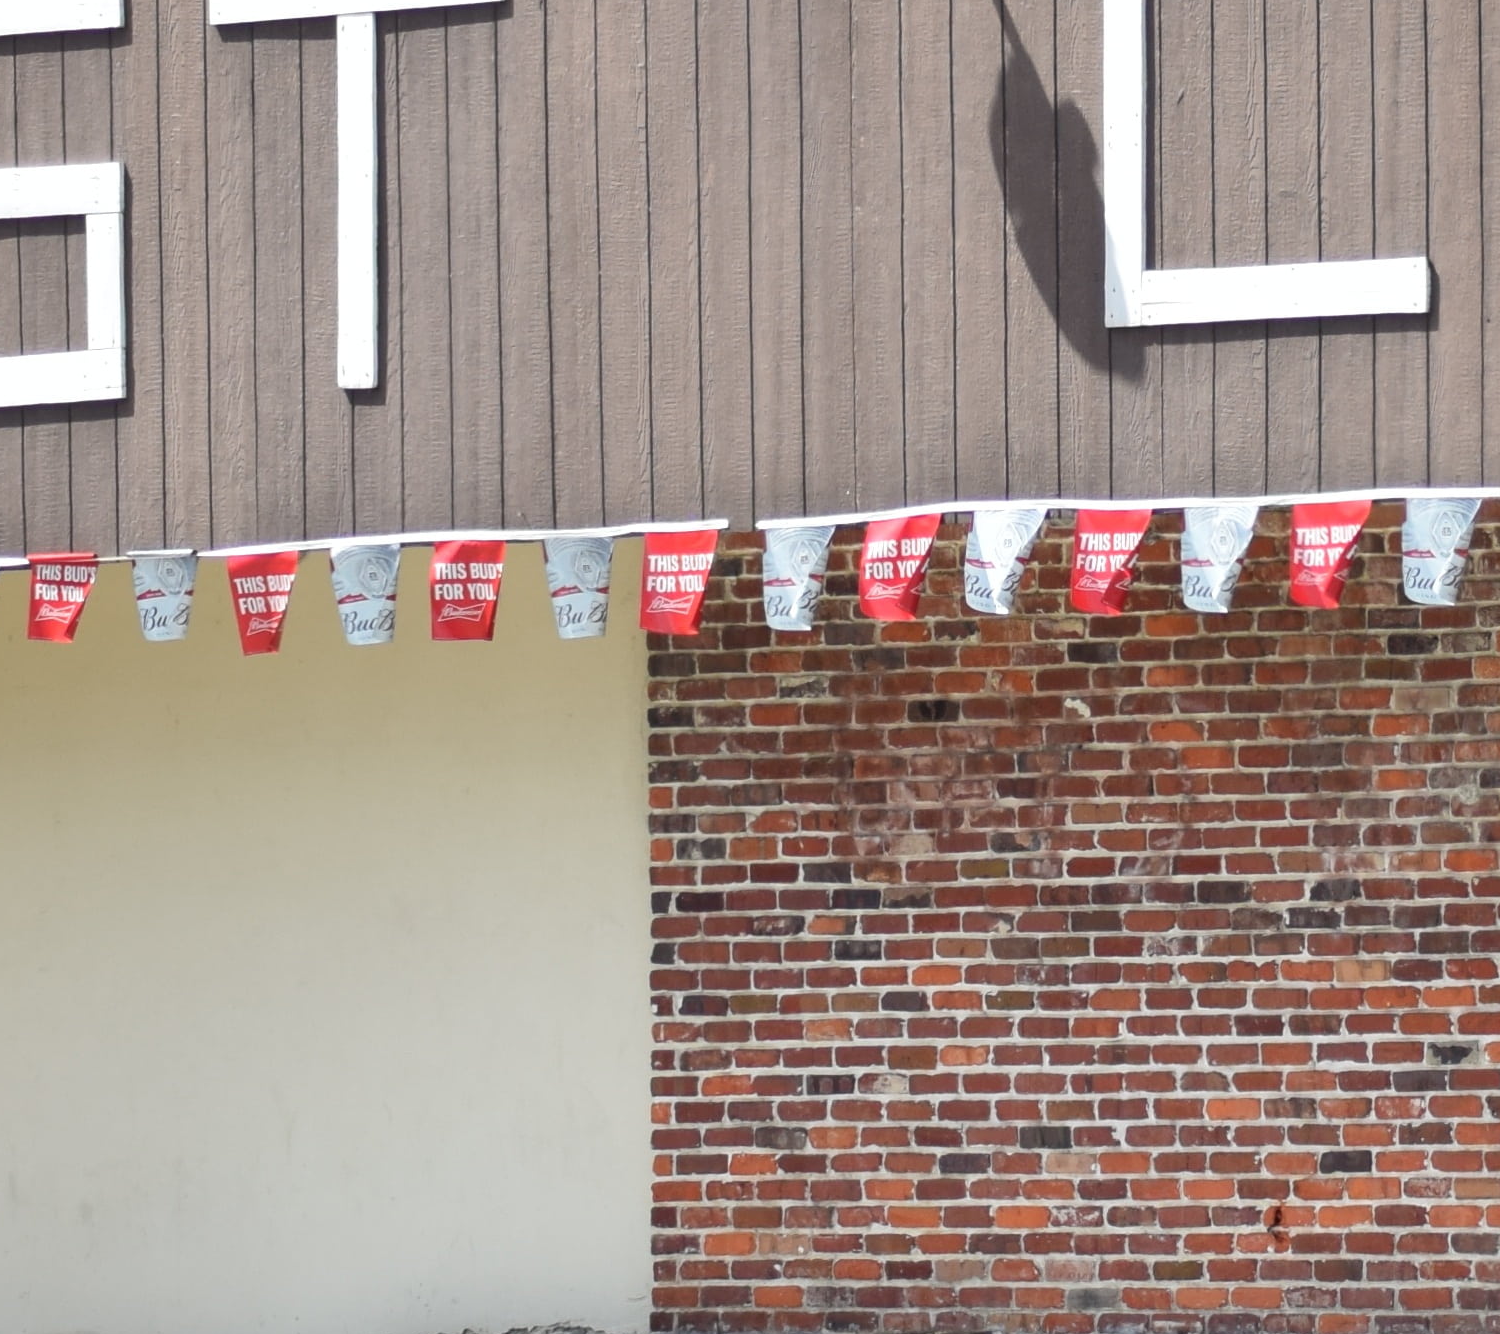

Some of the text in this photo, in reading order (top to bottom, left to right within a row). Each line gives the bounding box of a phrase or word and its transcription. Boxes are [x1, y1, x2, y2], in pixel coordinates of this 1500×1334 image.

[1079, 533, 1111, 551] THIS
[1295, 528, 1329, 545] THIS
[867, 539, 898, 560] THIS
[1293, 547, 1325, 566] FOR
[434, 563, 466, 579] THIS
[648, 555, 678, 572] THIS
[865, 560, 894, 579] FOR
[1076, 553, 1108, 572] FOR
[35, 565, 61, 581] THIS
[35, 584, 58, 601] FOR
[234, 576, 265, 594] THIS
[434, 583, 497, 600] FOR YOU.
[647, 576, 676, 592] FOR
[238, 595, 267, 615] FOR
